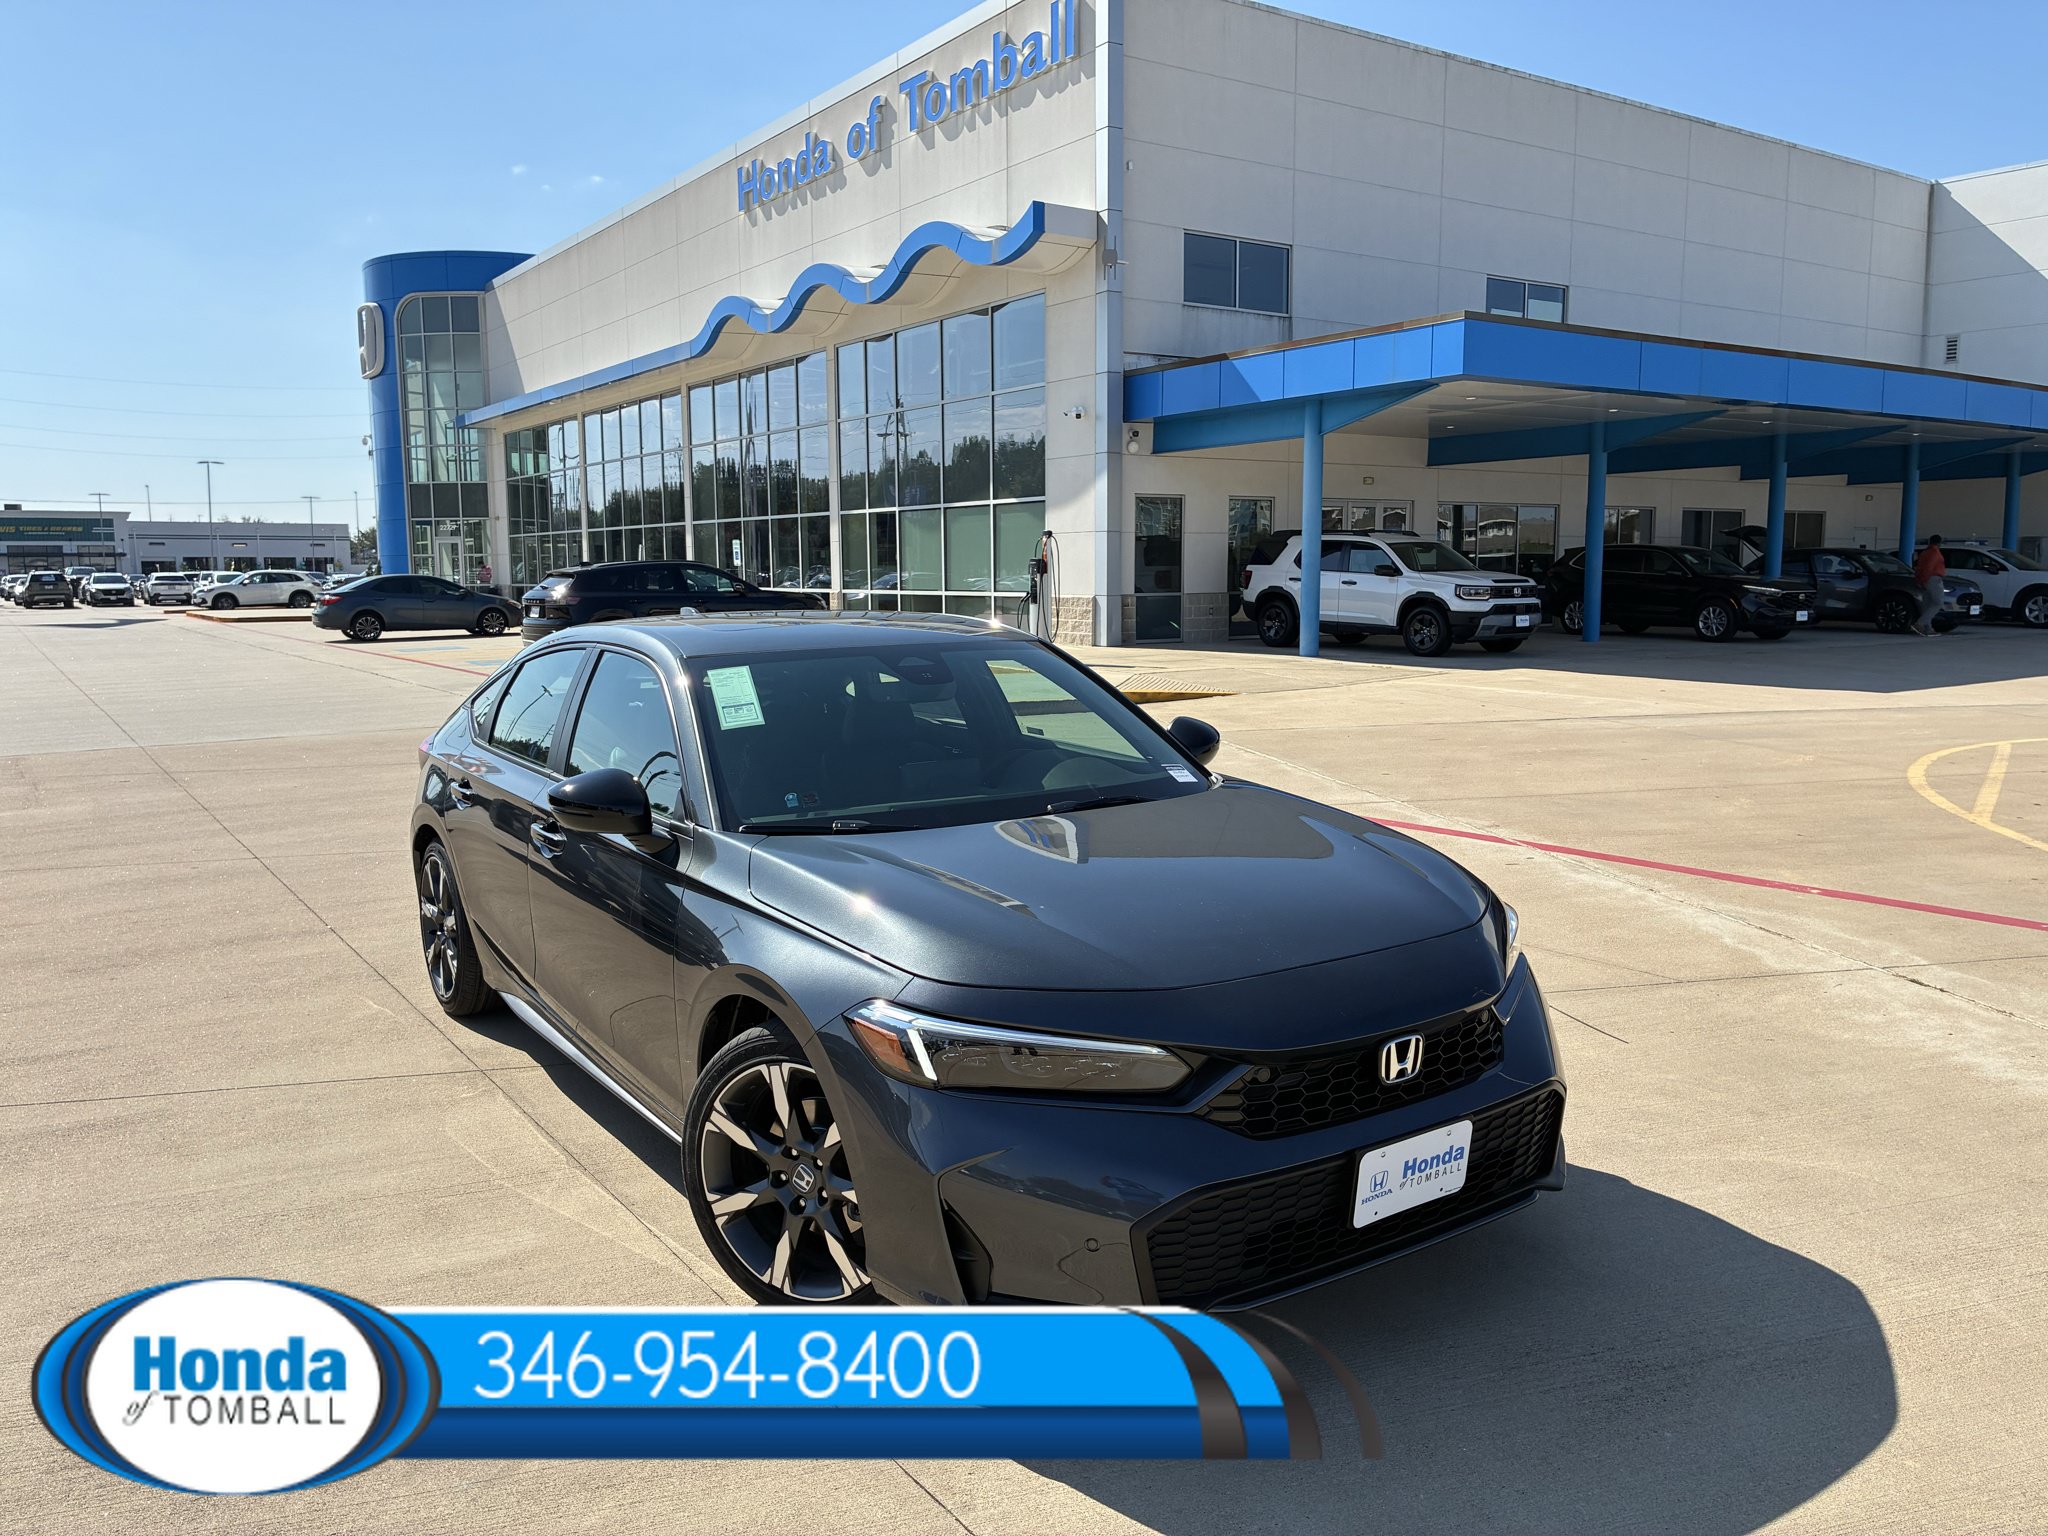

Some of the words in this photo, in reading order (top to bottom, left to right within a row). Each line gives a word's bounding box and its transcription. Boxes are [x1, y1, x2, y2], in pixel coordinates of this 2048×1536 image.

[738, 132, 835, 212] Honda
[847, 95, 886, 159] of
[899, 0, 1078, 133] Tomball
[1399, 1176, 1410, 1191] of
[1409, 1162, 1462, 1188] TOMBALL
[1402, 1145, 1465, 1179] Honda
[1361, 1188, 1393, 1206] HONDA
